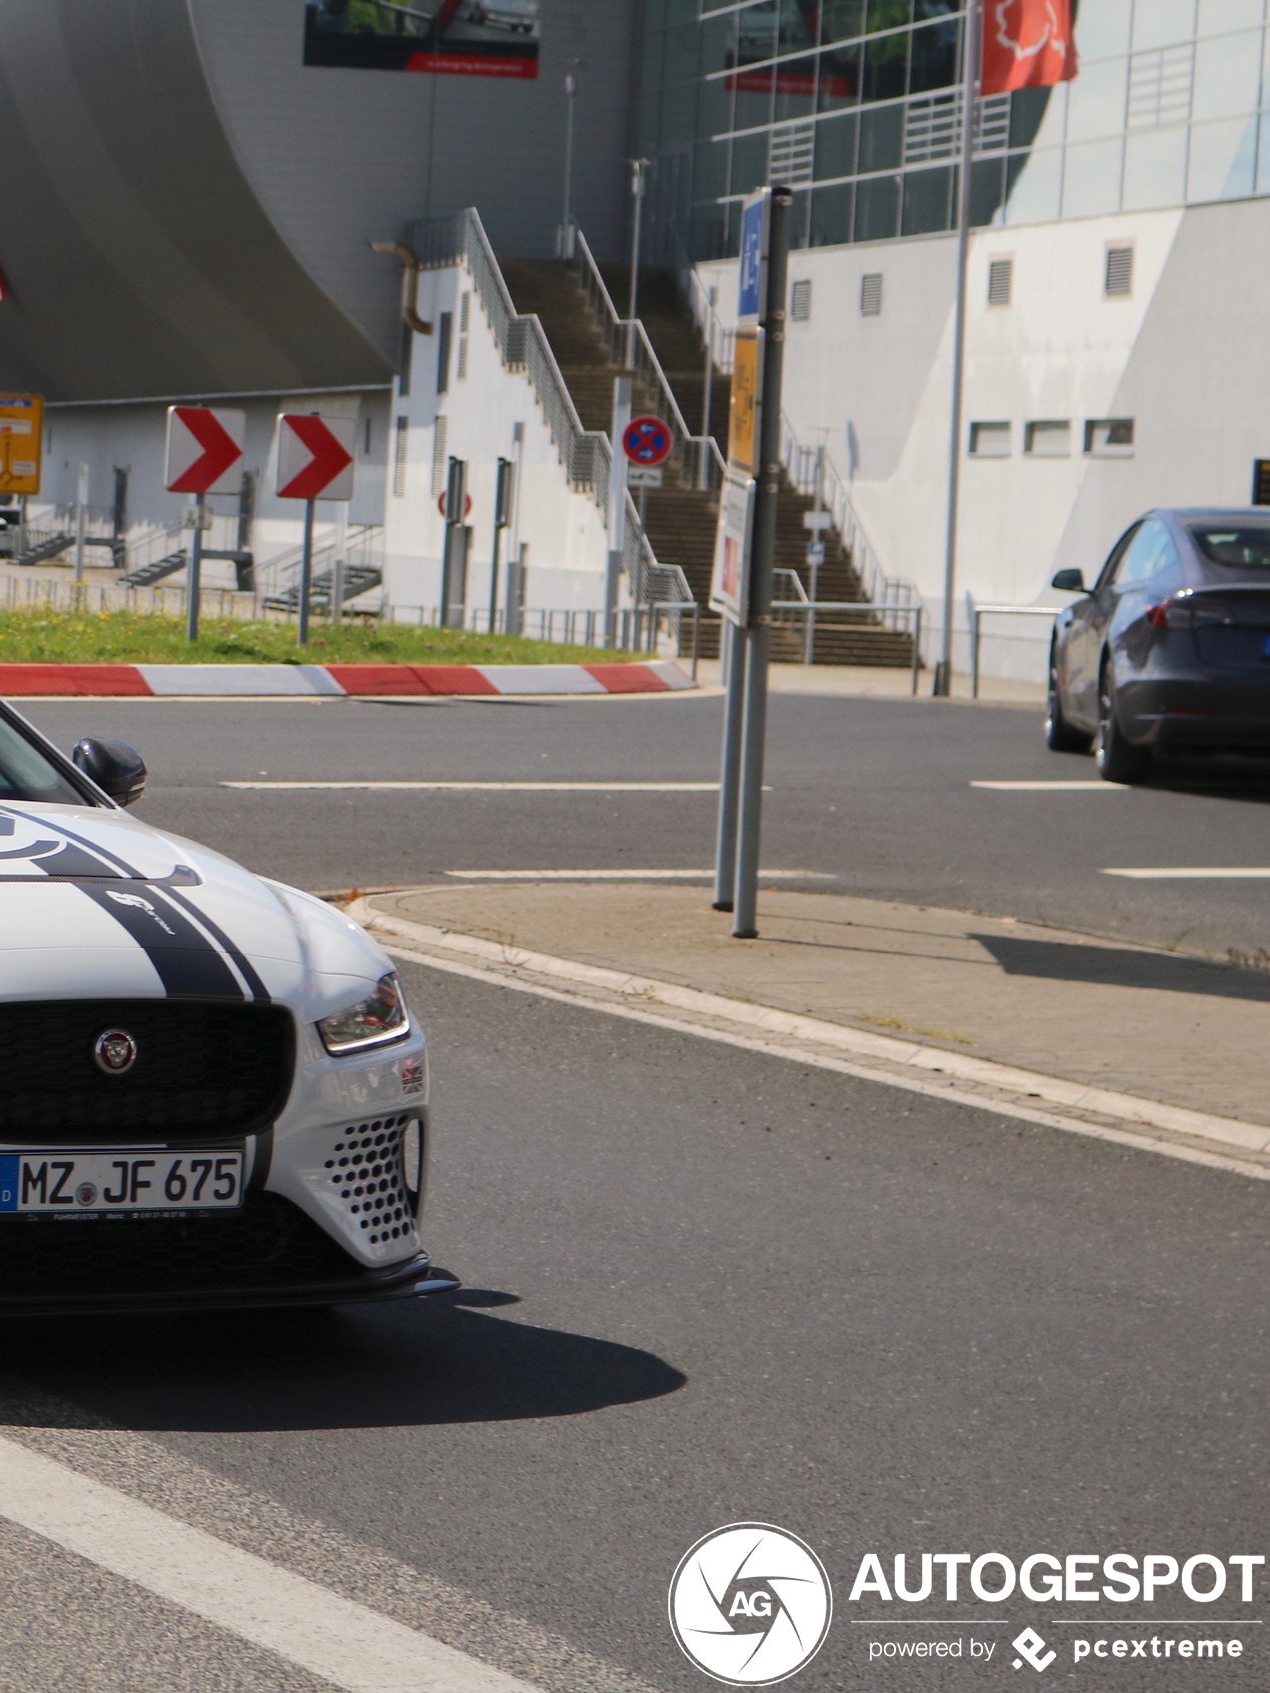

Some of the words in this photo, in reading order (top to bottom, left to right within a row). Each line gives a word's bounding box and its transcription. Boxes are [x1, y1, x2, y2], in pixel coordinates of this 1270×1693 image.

[2, 1189, 12, 1202] D
[21, 1161, 75, 1204] MZ
[104, 1160, 156, 1203] JF
[165, 1158, 238, 1202] 675
